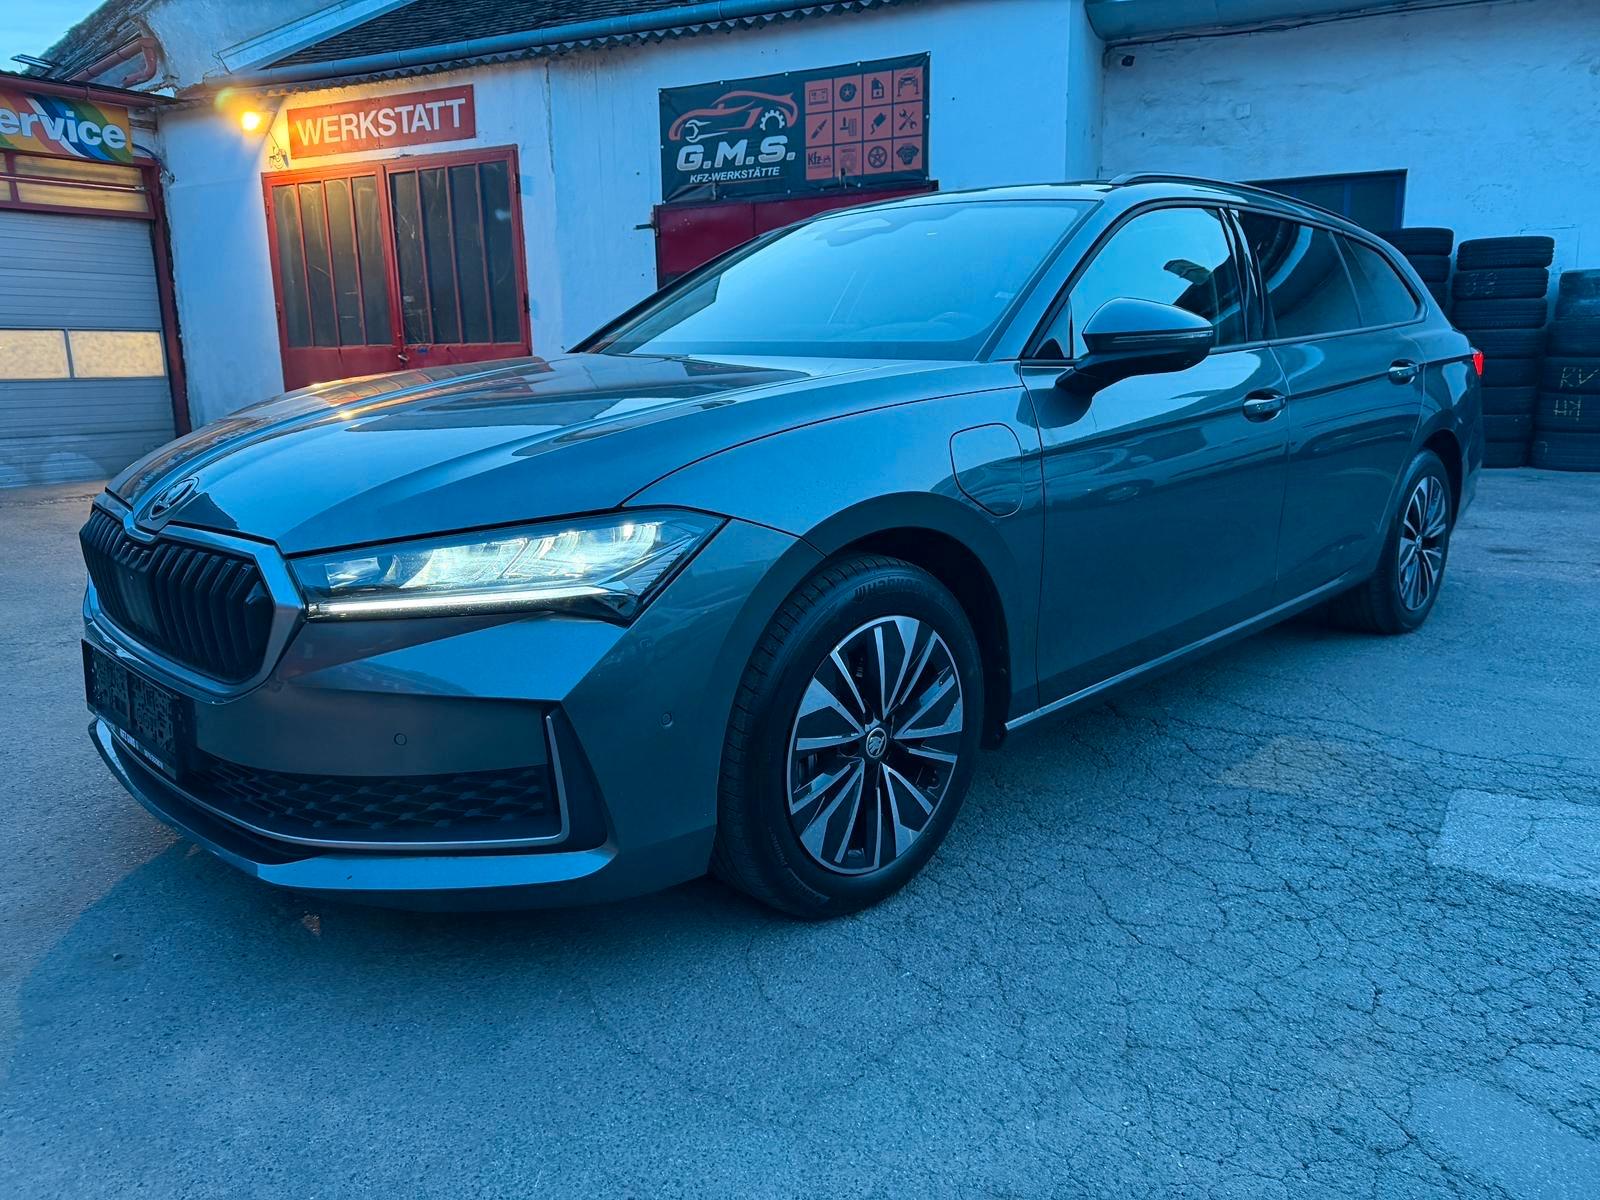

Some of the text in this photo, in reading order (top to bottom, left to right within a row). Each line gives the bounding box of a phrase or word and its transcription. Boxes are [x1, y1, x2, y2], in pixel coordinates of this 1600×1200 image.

[296, 98, 466, 146] WERKSTATT
[676, 135, 796, 171] G.M.S.
[689, 166, 780, 184] KFZ-WERKSTÄTTE
